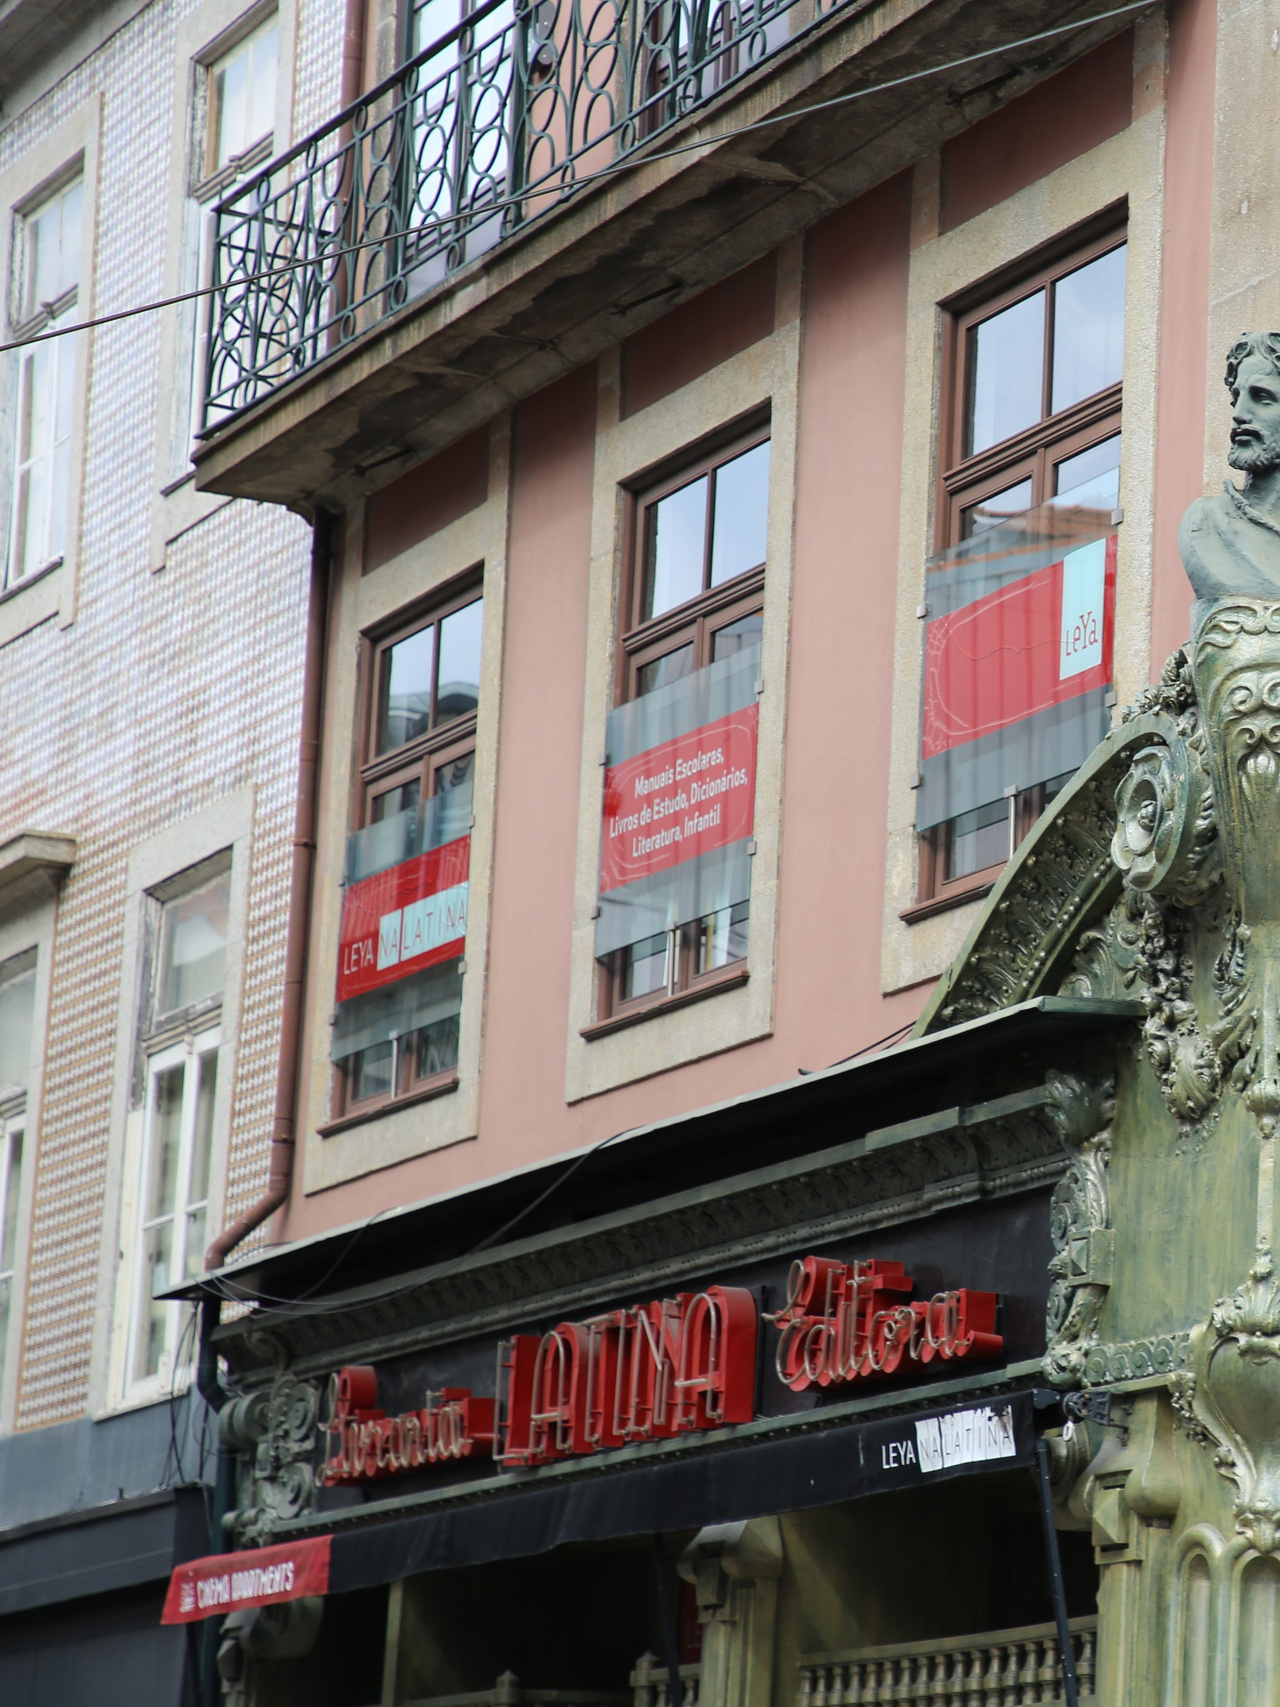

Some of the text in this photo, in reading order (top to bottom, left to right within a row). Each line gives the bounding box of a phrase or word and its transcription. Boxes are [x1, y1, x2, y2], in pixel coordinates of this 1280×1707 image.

[634, 747, 724, 798] Manuais Escolares,
[610, 767, 748, 838] Livros de Estudo, Dicionários,
[632, 803, 721, 858] Literatura, Infantil
[343, 899, 467, 975] LEYA NA LATINA
[493, 1285, 758, 1468] LATINA
[761, 1255, 1004, 1392] Editora
[881, 1422, 1013, 1469] LEYA NA LATINA
[196, 1574, 230, 1610] CINEMA
